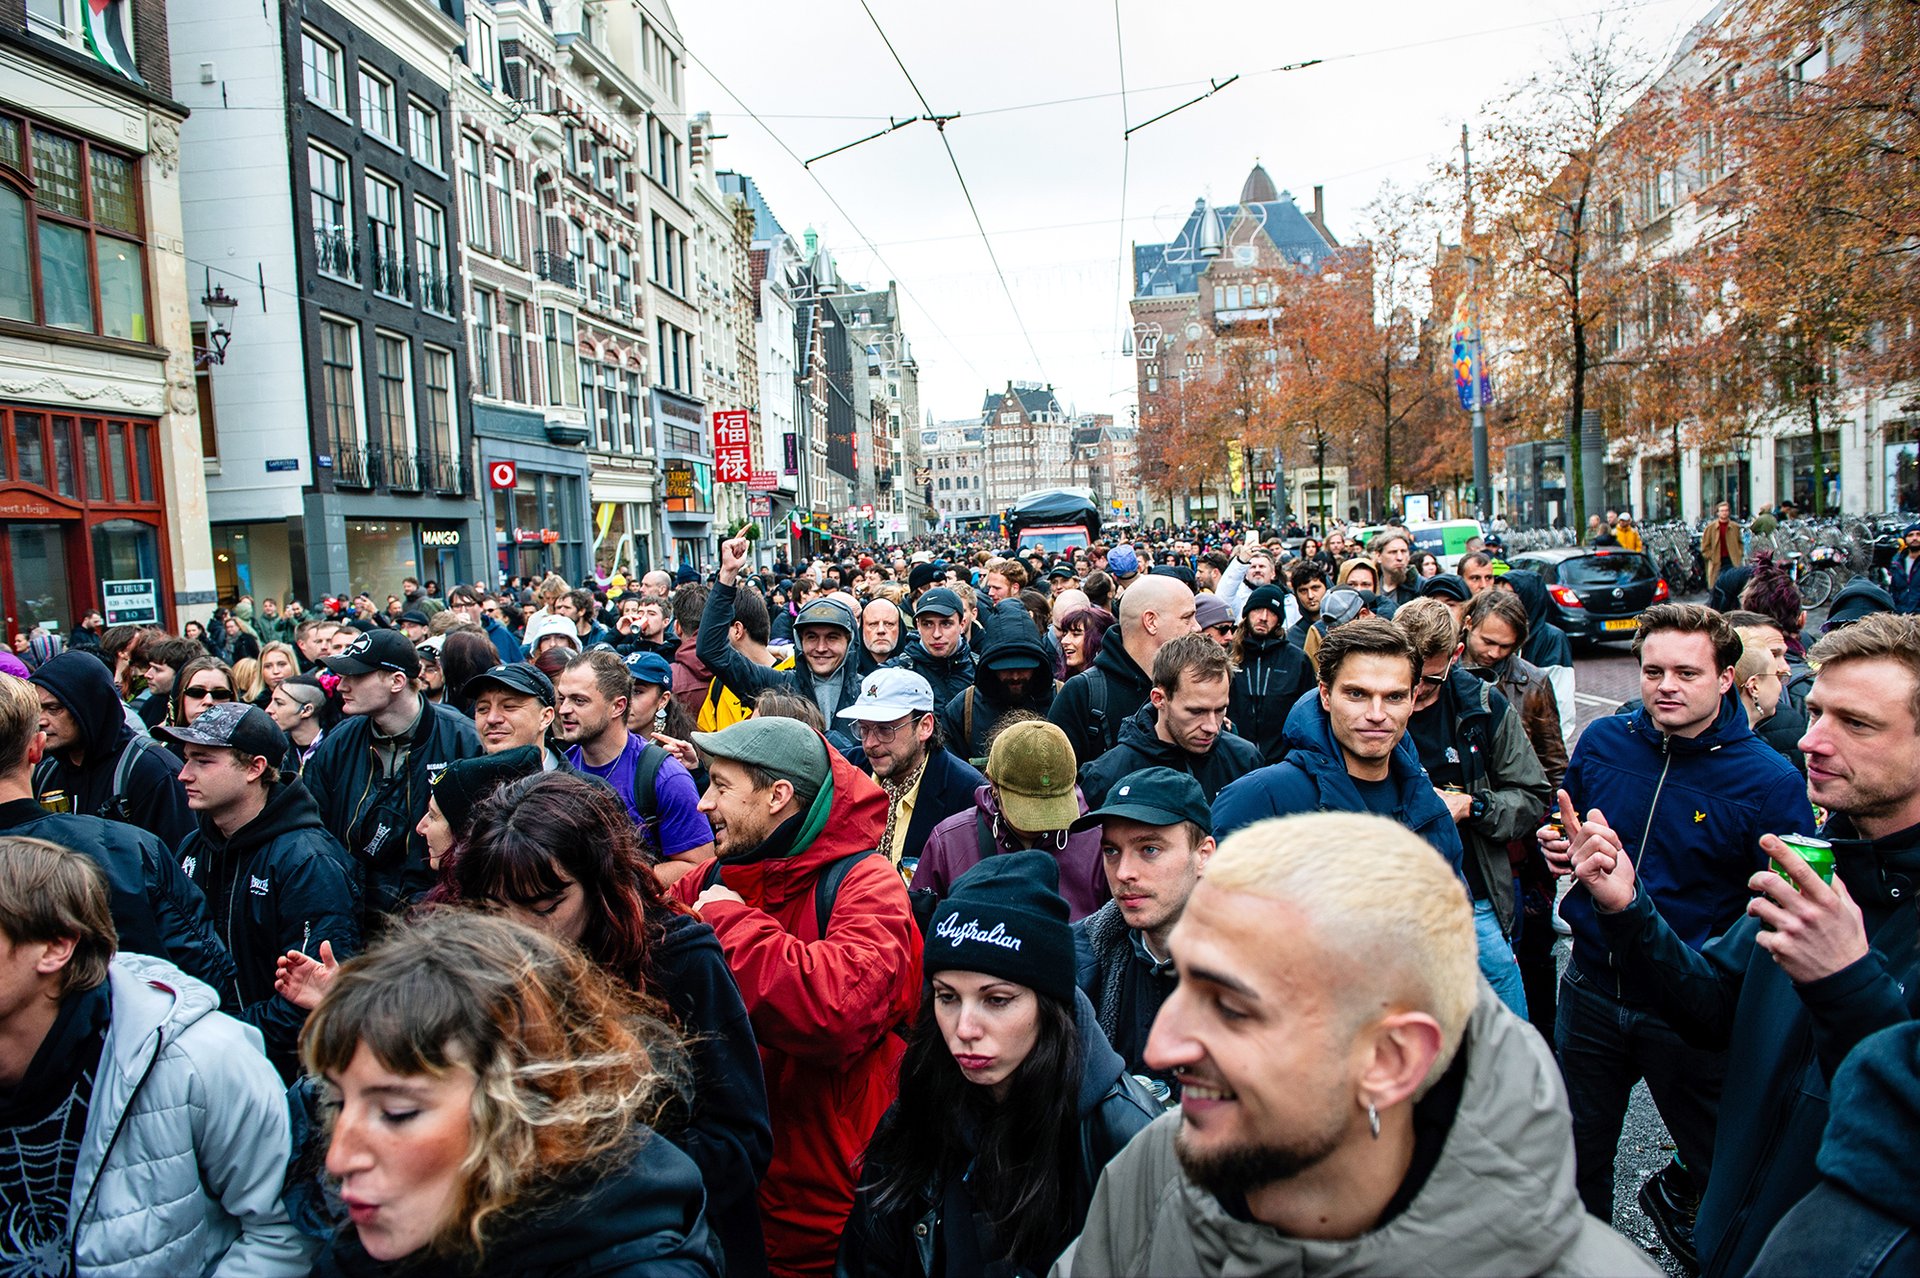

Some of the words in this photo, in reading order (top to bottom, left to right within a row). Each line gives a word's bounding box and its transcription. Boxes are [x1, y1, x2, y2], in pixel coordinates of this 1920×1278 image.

[716, 414, 749, 480] 福禄
[422, 530, 460, 545] MANGO
[113, 585, 122, 594] TE
[123, 584, 145, 593] HUUR
[935, 911, 1022, 951] Australian
